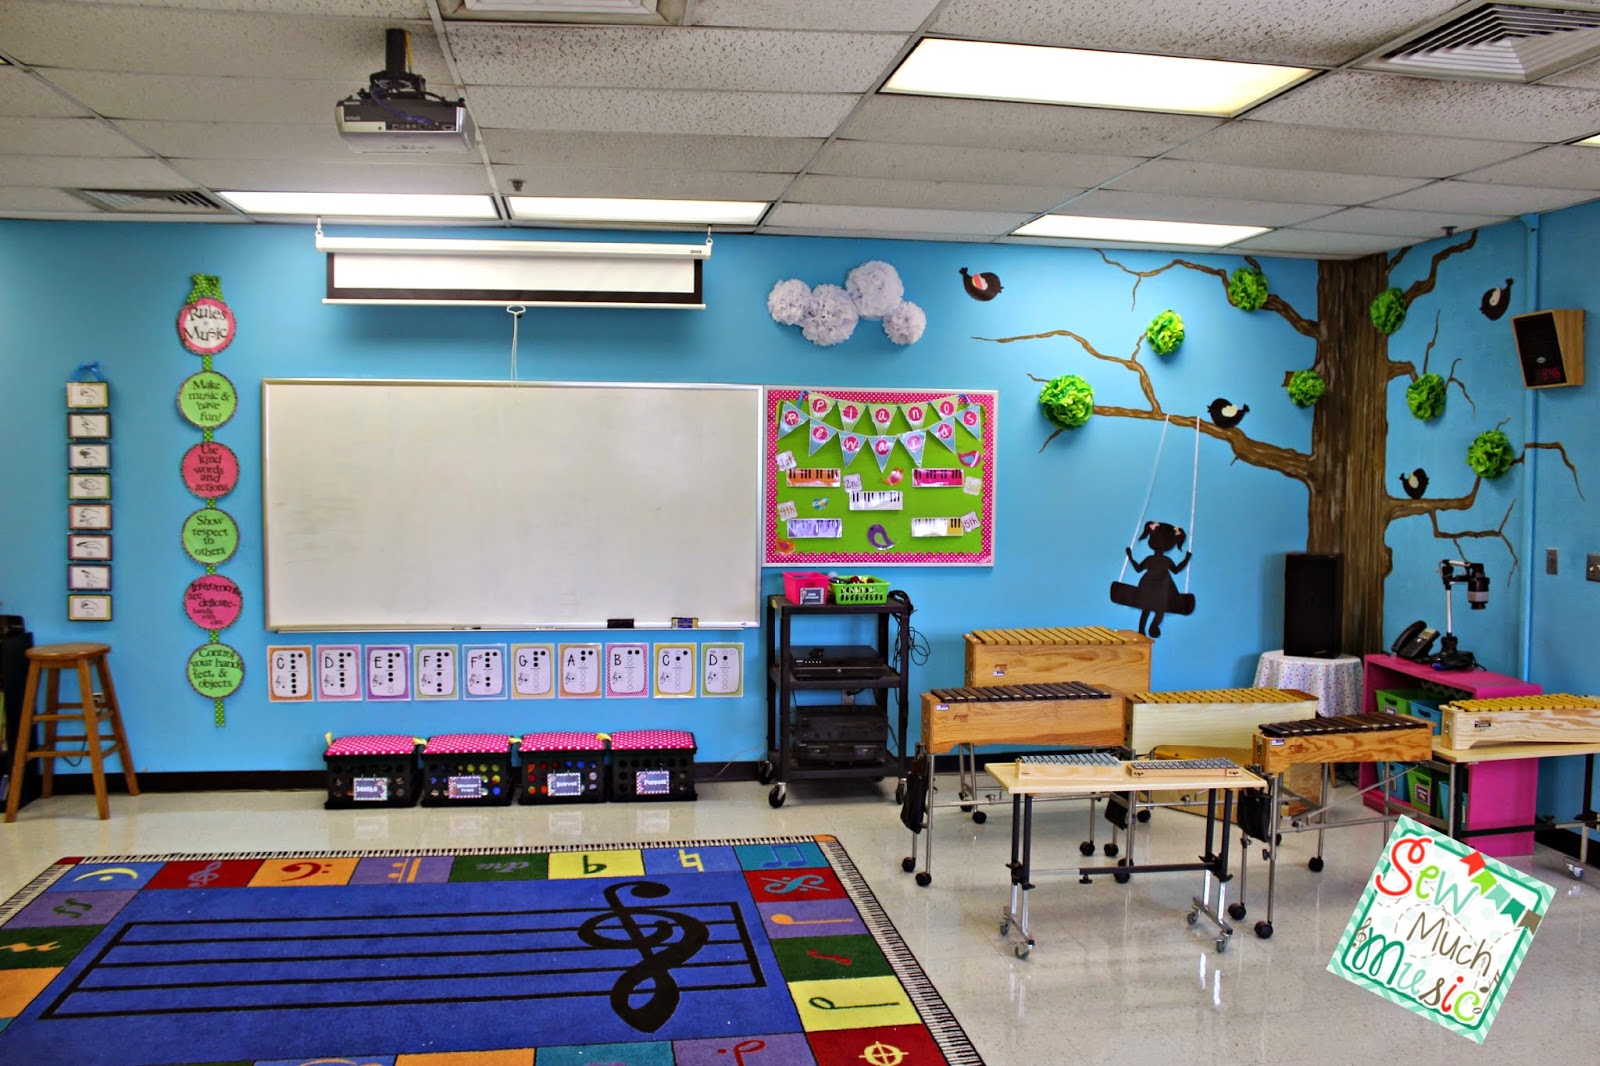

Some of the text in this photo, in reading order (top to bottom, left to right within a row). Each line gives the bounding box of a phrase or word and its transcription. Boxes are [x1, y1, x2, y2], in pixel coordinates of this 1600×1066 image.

[188, 304, 228, 321] Rules
[183, 326, 228, 342] Music
[193, 379, 221, 390] Make
[188, 391, 231, 401] music &
[196, 401, 221, 410] have
[812, 398, 952, 421] Piano
[200, 411, 222, 422] fun!
[200, 444, 219, 455] Use
[198, 455, 222, 464] kind
[779, 455, 794, 469] 1st
[193, 465, 224, 475] words
[200, 474, 221, 483] and
[845, 478, 861, 489] 2nd
[780, 506, 796, 518] 4th
[196, 515, 224, 526] Show
[963, 516, 979, 530] 5th
[191, 528, 229, 538] respect
[194, 546, 226, 557] others
[198, 647, 235, 660] Control
[190, 659, 213, 668] your
[276, 657, 285, 670] C
[324, 657, 334, 669] D
[374, 657, 383, 669] E
[423, 655, 431, 667] F
[518, 655, 528, 667] G
[567, 654, 576, 666] A
[613, 654, 622, 666] B
[662, 655, 670, 667] C
[708, 654, 718, 666] D
[218, 668, 228, 678] &
